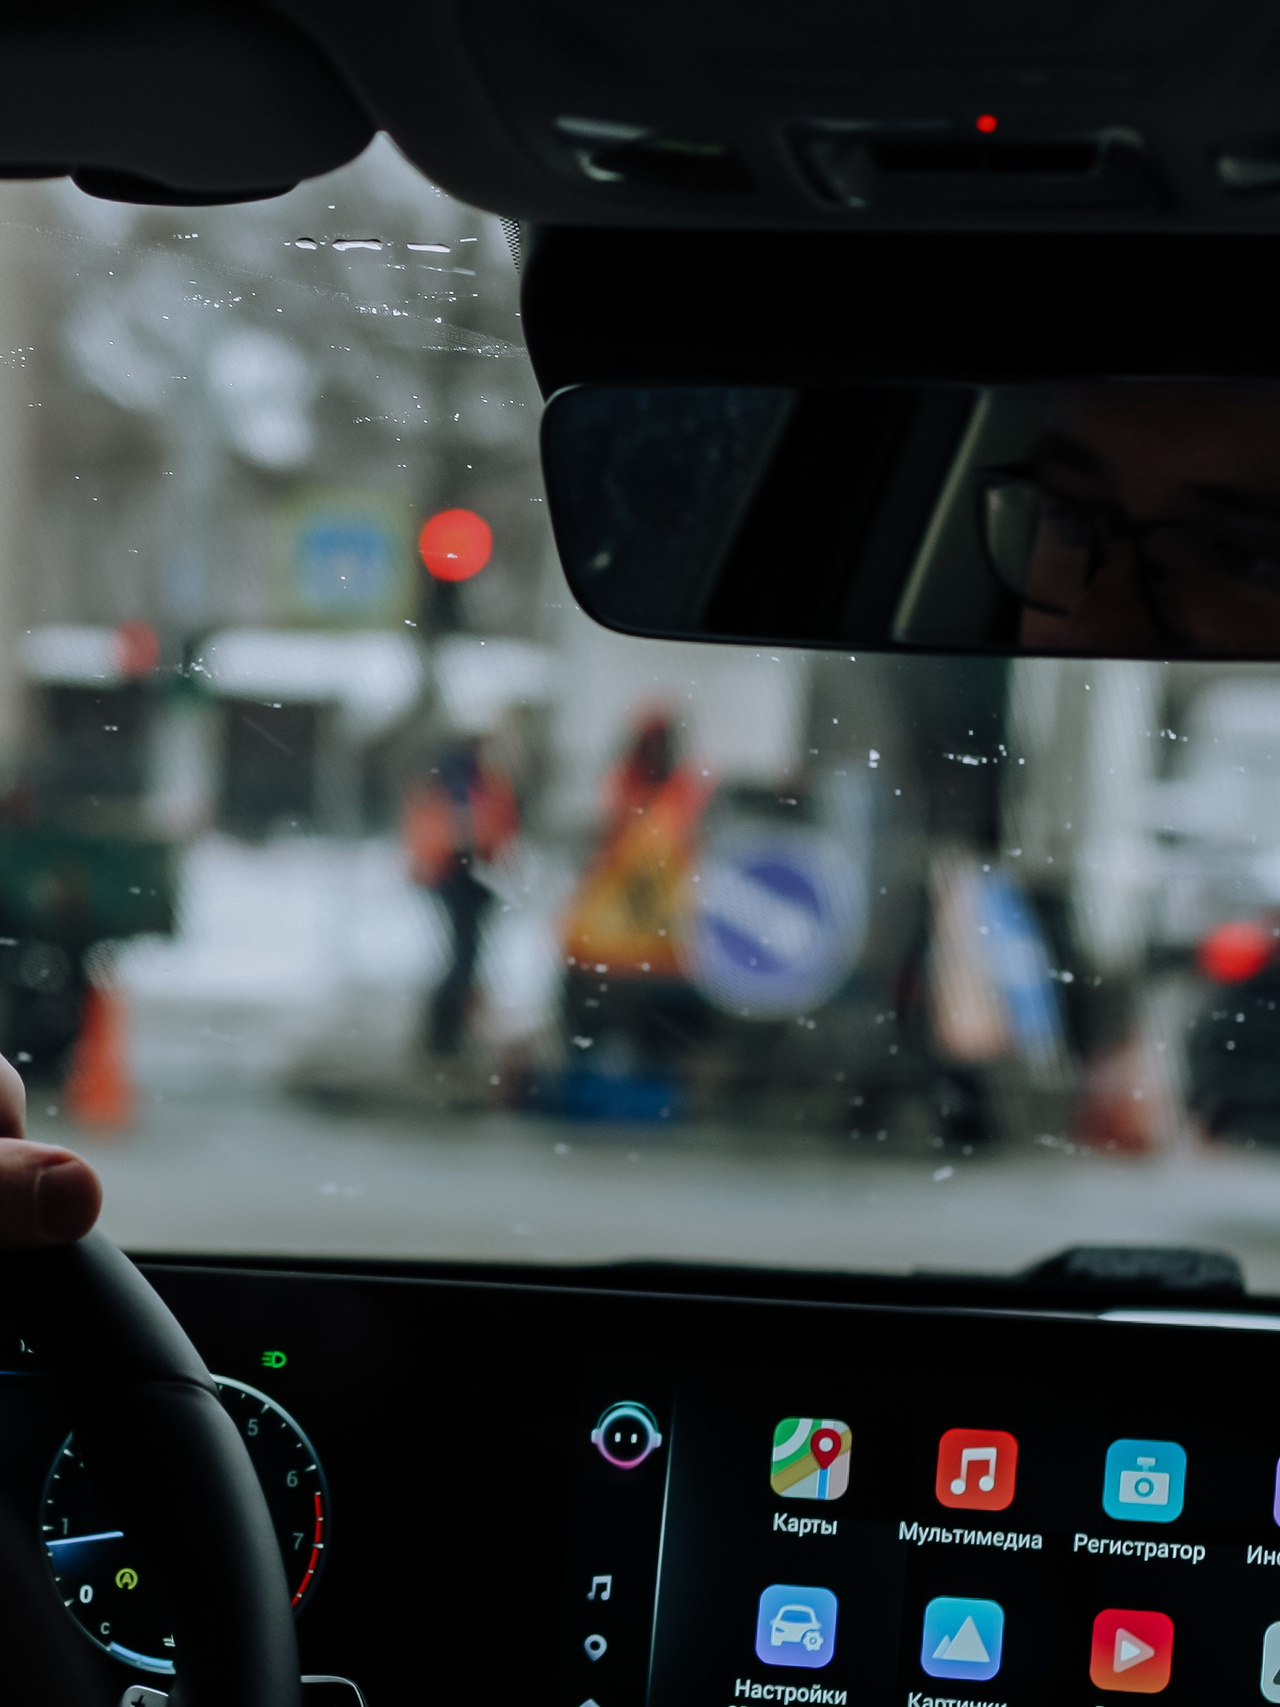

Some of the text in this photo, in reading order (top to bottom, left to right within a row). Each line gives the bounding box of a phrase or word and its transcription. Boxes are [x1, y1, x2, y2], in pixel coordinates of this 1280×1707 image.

[247, 1419, 259, 1436] 5
[286, 1470, 298, 1487] 6
[772, 1512, 838, 1538] Карты
[898, 1520, 1043, 1552] Мультимедиа
[292, 1532, 305, 1550] 7
[1073, 1533, 1206, 1565] Регистратор
[79, 1584, 94, 1604] 0
[734, 1677, 848, 1706] Настройки
